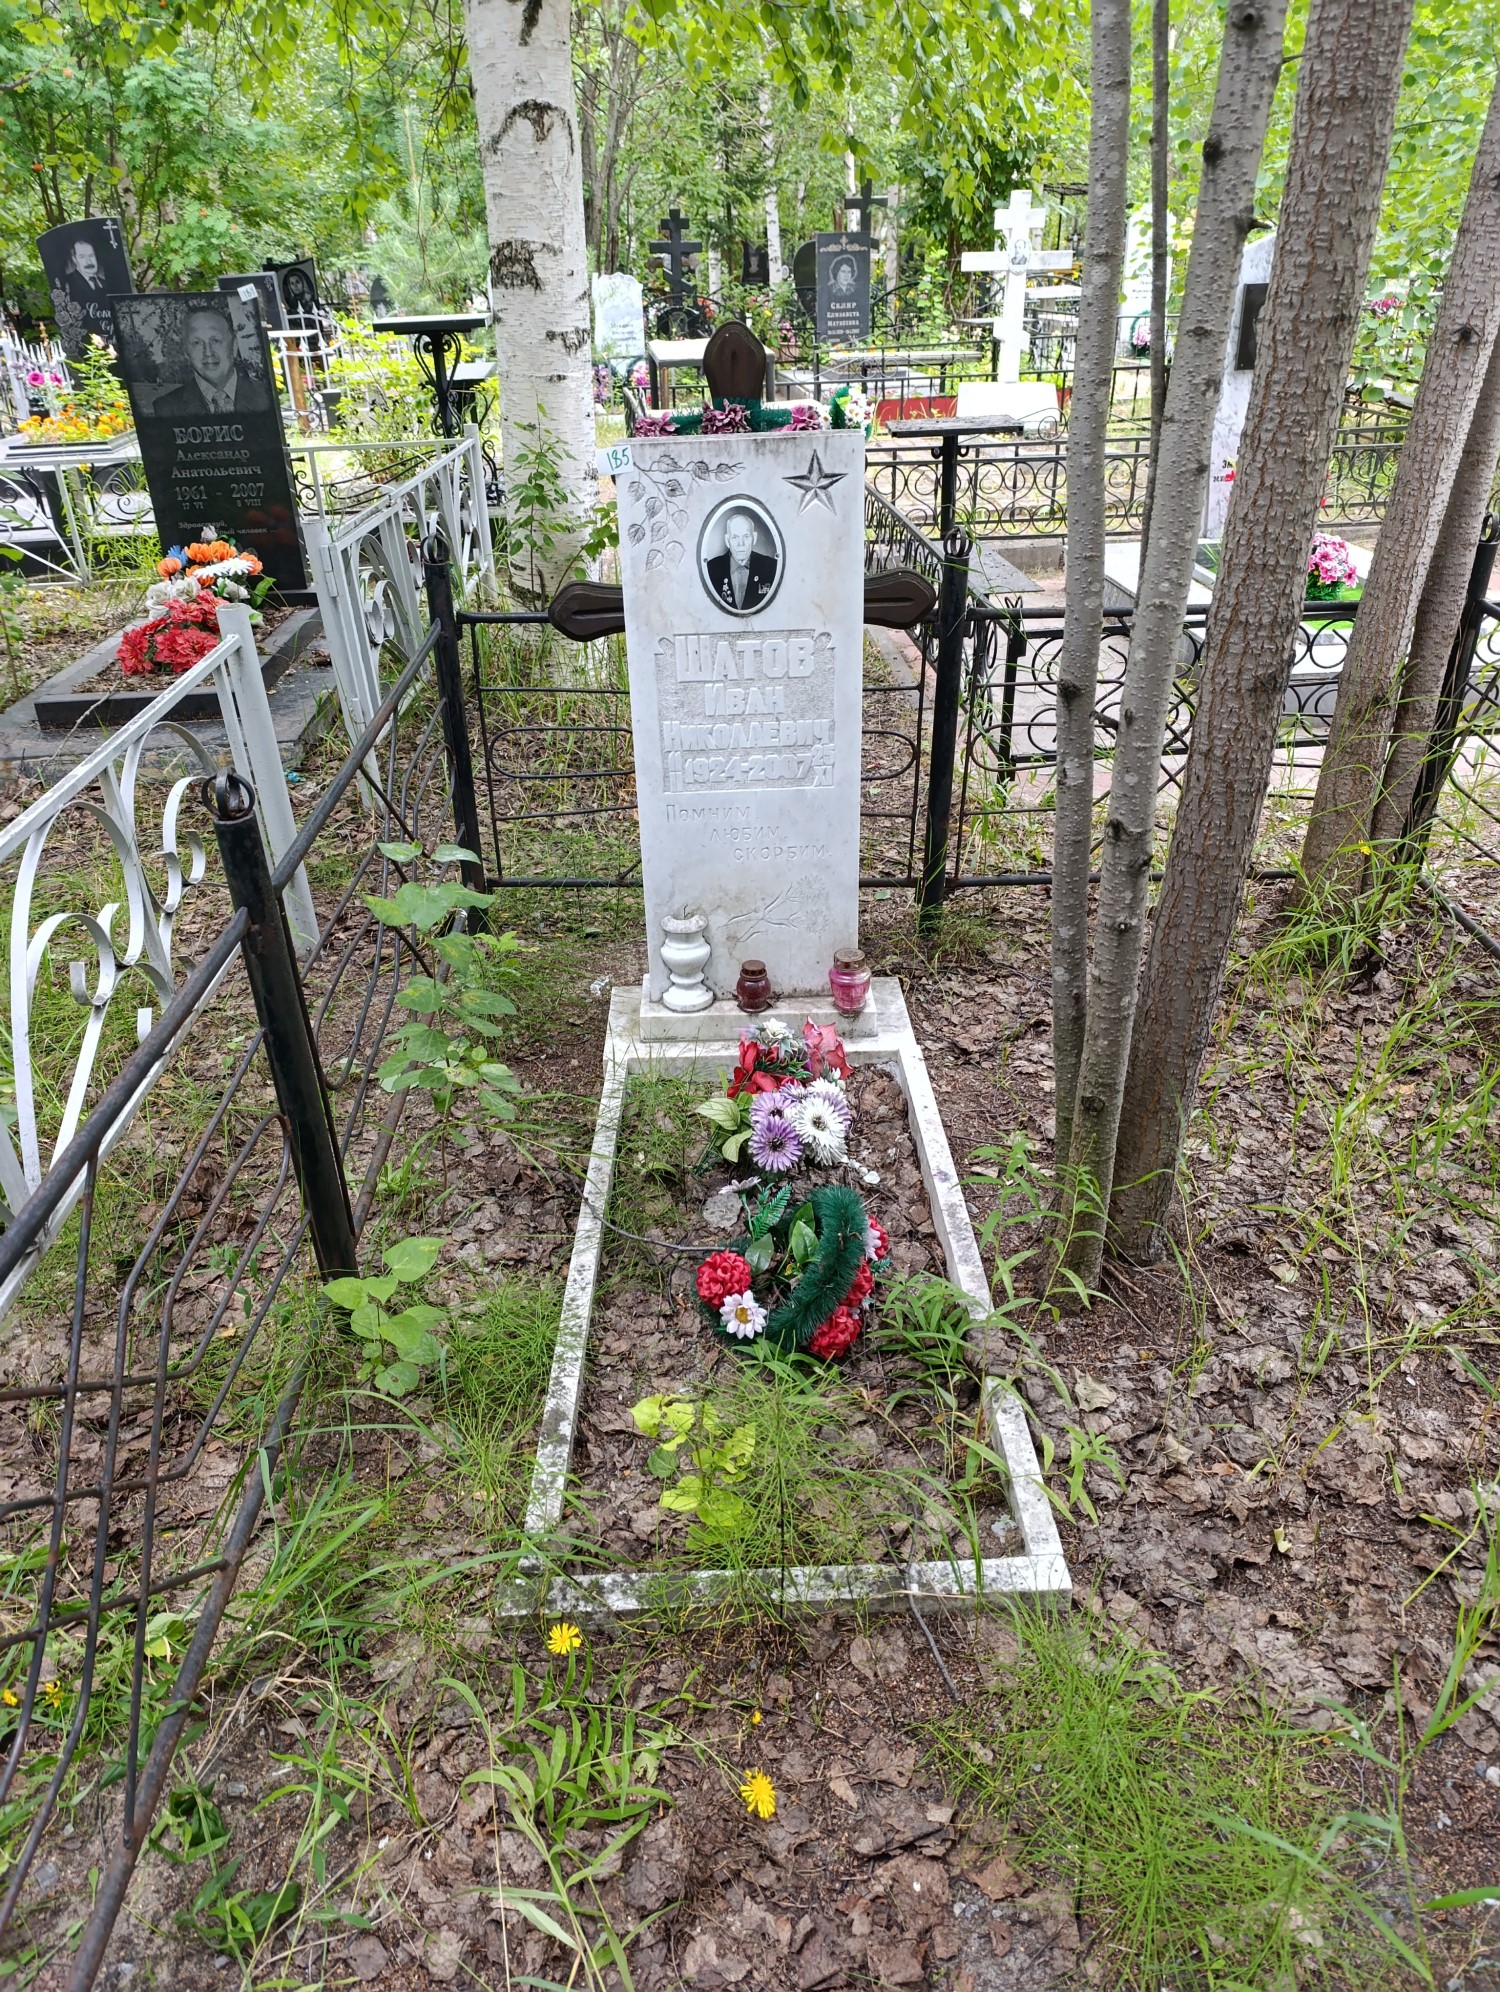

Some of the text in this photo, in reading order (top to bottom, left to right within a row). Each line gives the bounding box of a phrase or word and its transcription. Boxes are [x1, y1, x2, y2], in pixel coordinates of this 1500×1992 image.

[173, 424, 245, 444] БОРИС
[176, 449, 250, 462] Александр
[606, 446, 630, 471] 185
[171, 465, 262, 479] Анатольевич
[174, 485, 208, 501] 1961
[230, 482, 265, 498] 2007
[194, 501, 204, 510] VI
[674, 634, 815, 683] ШАТОВ
